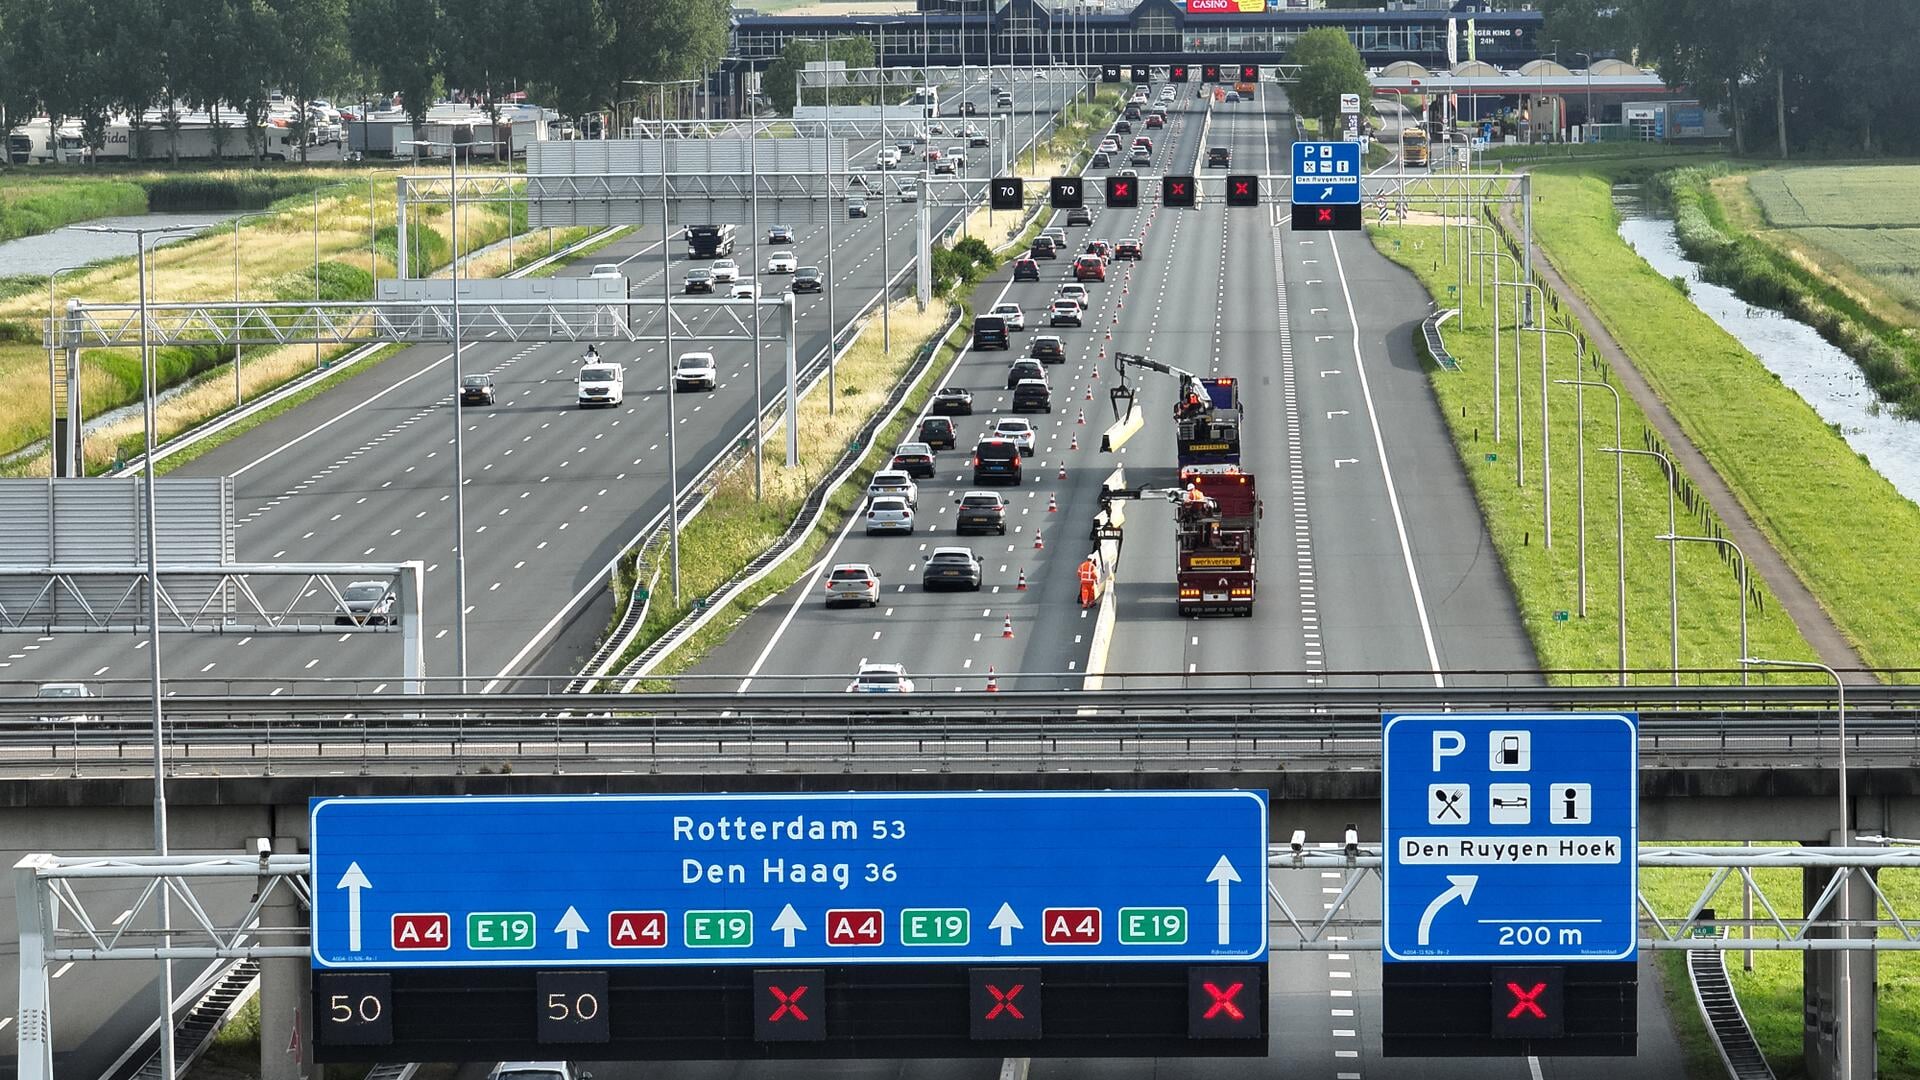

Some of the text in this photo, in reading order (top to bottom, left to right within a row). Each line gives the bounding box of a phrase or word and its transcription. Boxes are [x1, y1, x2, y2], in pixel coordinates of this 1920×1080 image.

[1193, 0, 1227, 8] CASINO
[1305, 146, 1315, 158] P
[1001, 186, 1015, 196] 70
[1061, 185, 1075, 195] 70
[1195, 558, 1237, 566] werkverkeer
[1433, 731, 1465, 771] P
[673, 816, 906, 841] Rotterdam 53
[1408, 840, 1616, 862] Den Ruygen Hoek
[682, 859, 897, 890] Den Haag 36
[400, 921, 443, 942] A4
[478, 920, 529, 941] E19
[617, 919, 660, 940] A4
[695, 918, 745, 939] E19
[834, 917, 877, 938] A4
[912, 917, 962, 937] E19
[1051, 916, 1094, 936] A4
[1130, 916, 1180, 936] E19
[1499, 927, 1582, 946] 200 m
[332, 995, 382, 1022] 50
[549, 993, 598, 1021] 50
